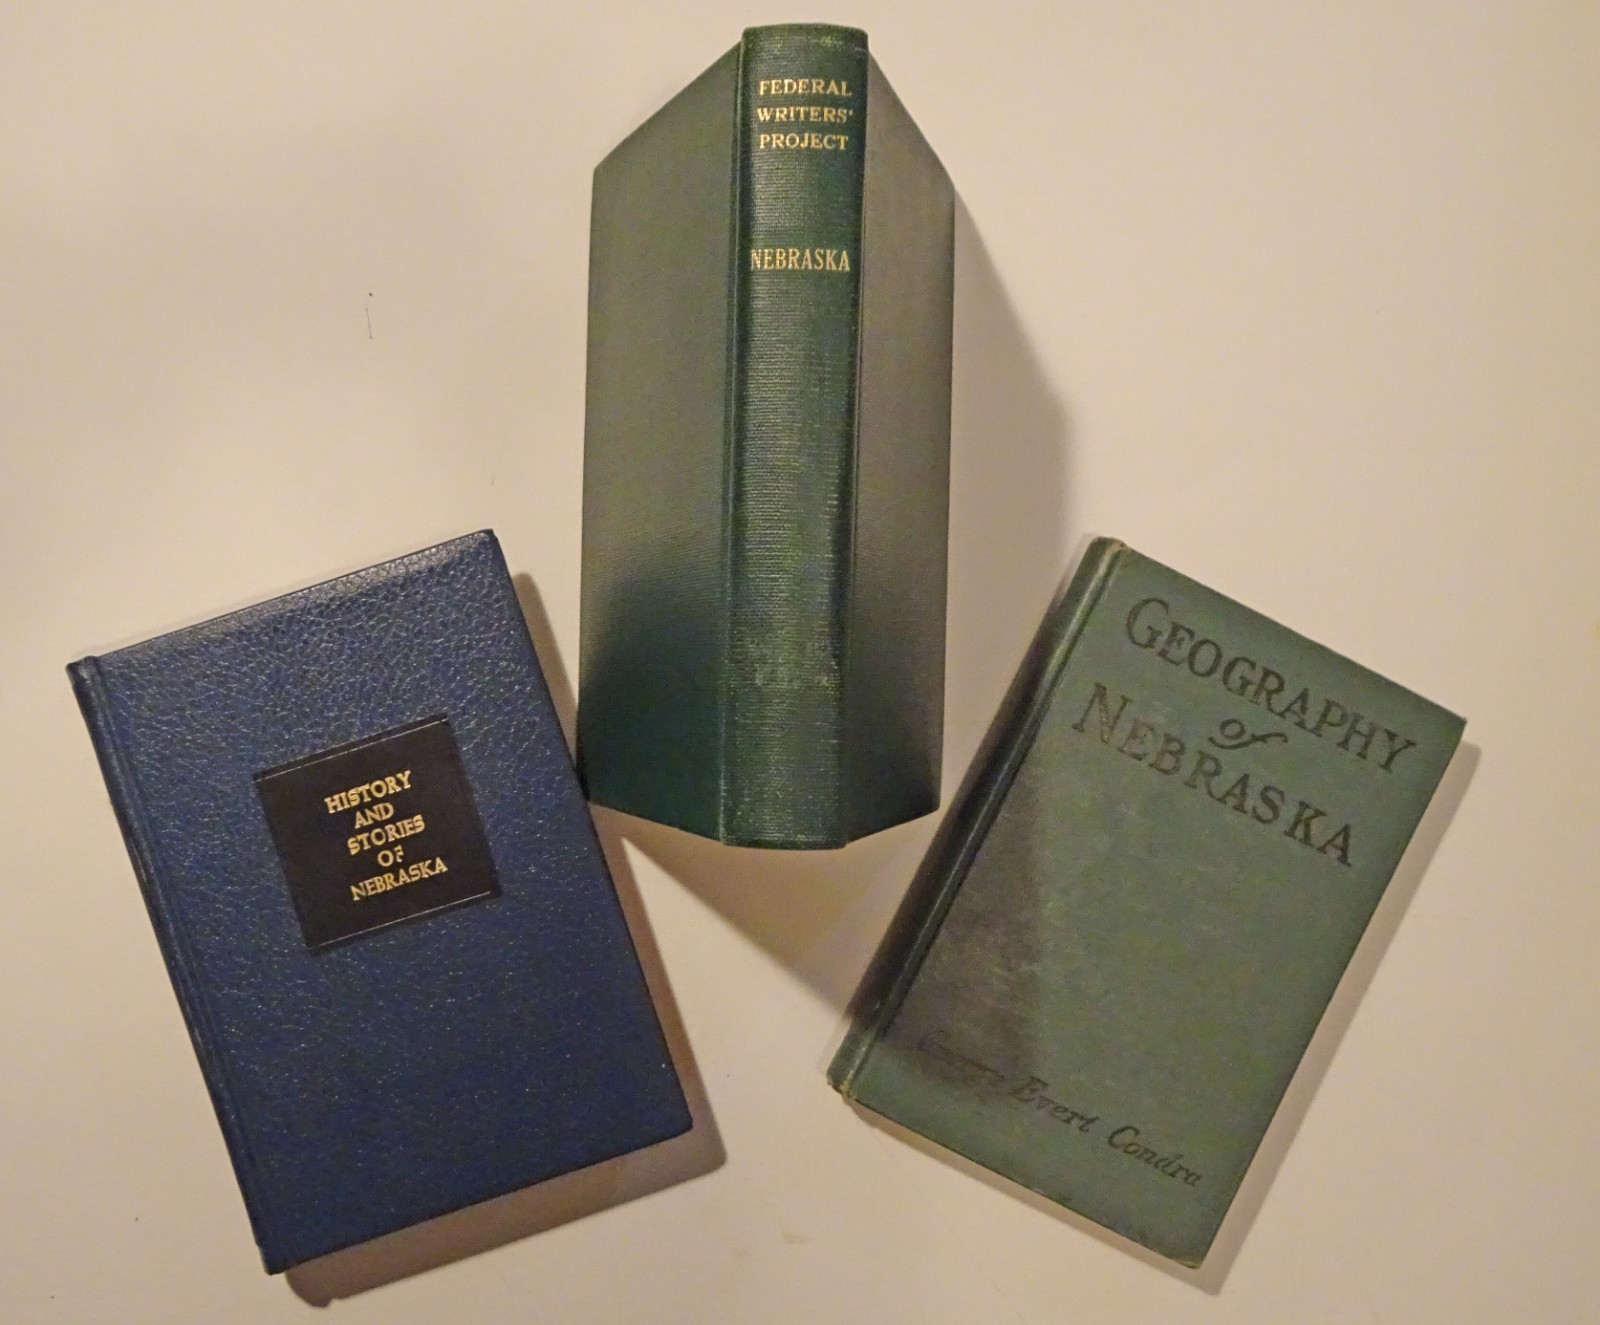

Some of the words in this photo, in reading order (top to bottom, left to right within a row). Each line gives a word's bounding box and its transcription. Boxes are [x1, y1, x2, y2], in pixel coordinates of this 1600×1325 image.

[758, 78, 853, 97] FEDERAL
[757, 106, 854, 124] WRITERS'
[758, 133, 850, 150] PROJECT
[750, 248, 851, 272] NEBRASKA
[1126, 597, 1417, 774] GEOGRAPHY
[1208, 718, 1289, 750] of
[1071, 682, 1354, 867] NEBRASKA
[323, 769, 412, 814] HISTORY
[354, 802, 395, 829] AND
[347, 814, 426, 856] STORIES
[377, 845, 404, 868] OF
[350, 857, 449, 901] NEBRASKA
[1012, 1075, 1101, 1133] Evert
[1107, 1125, 1202, 1188] Condra
